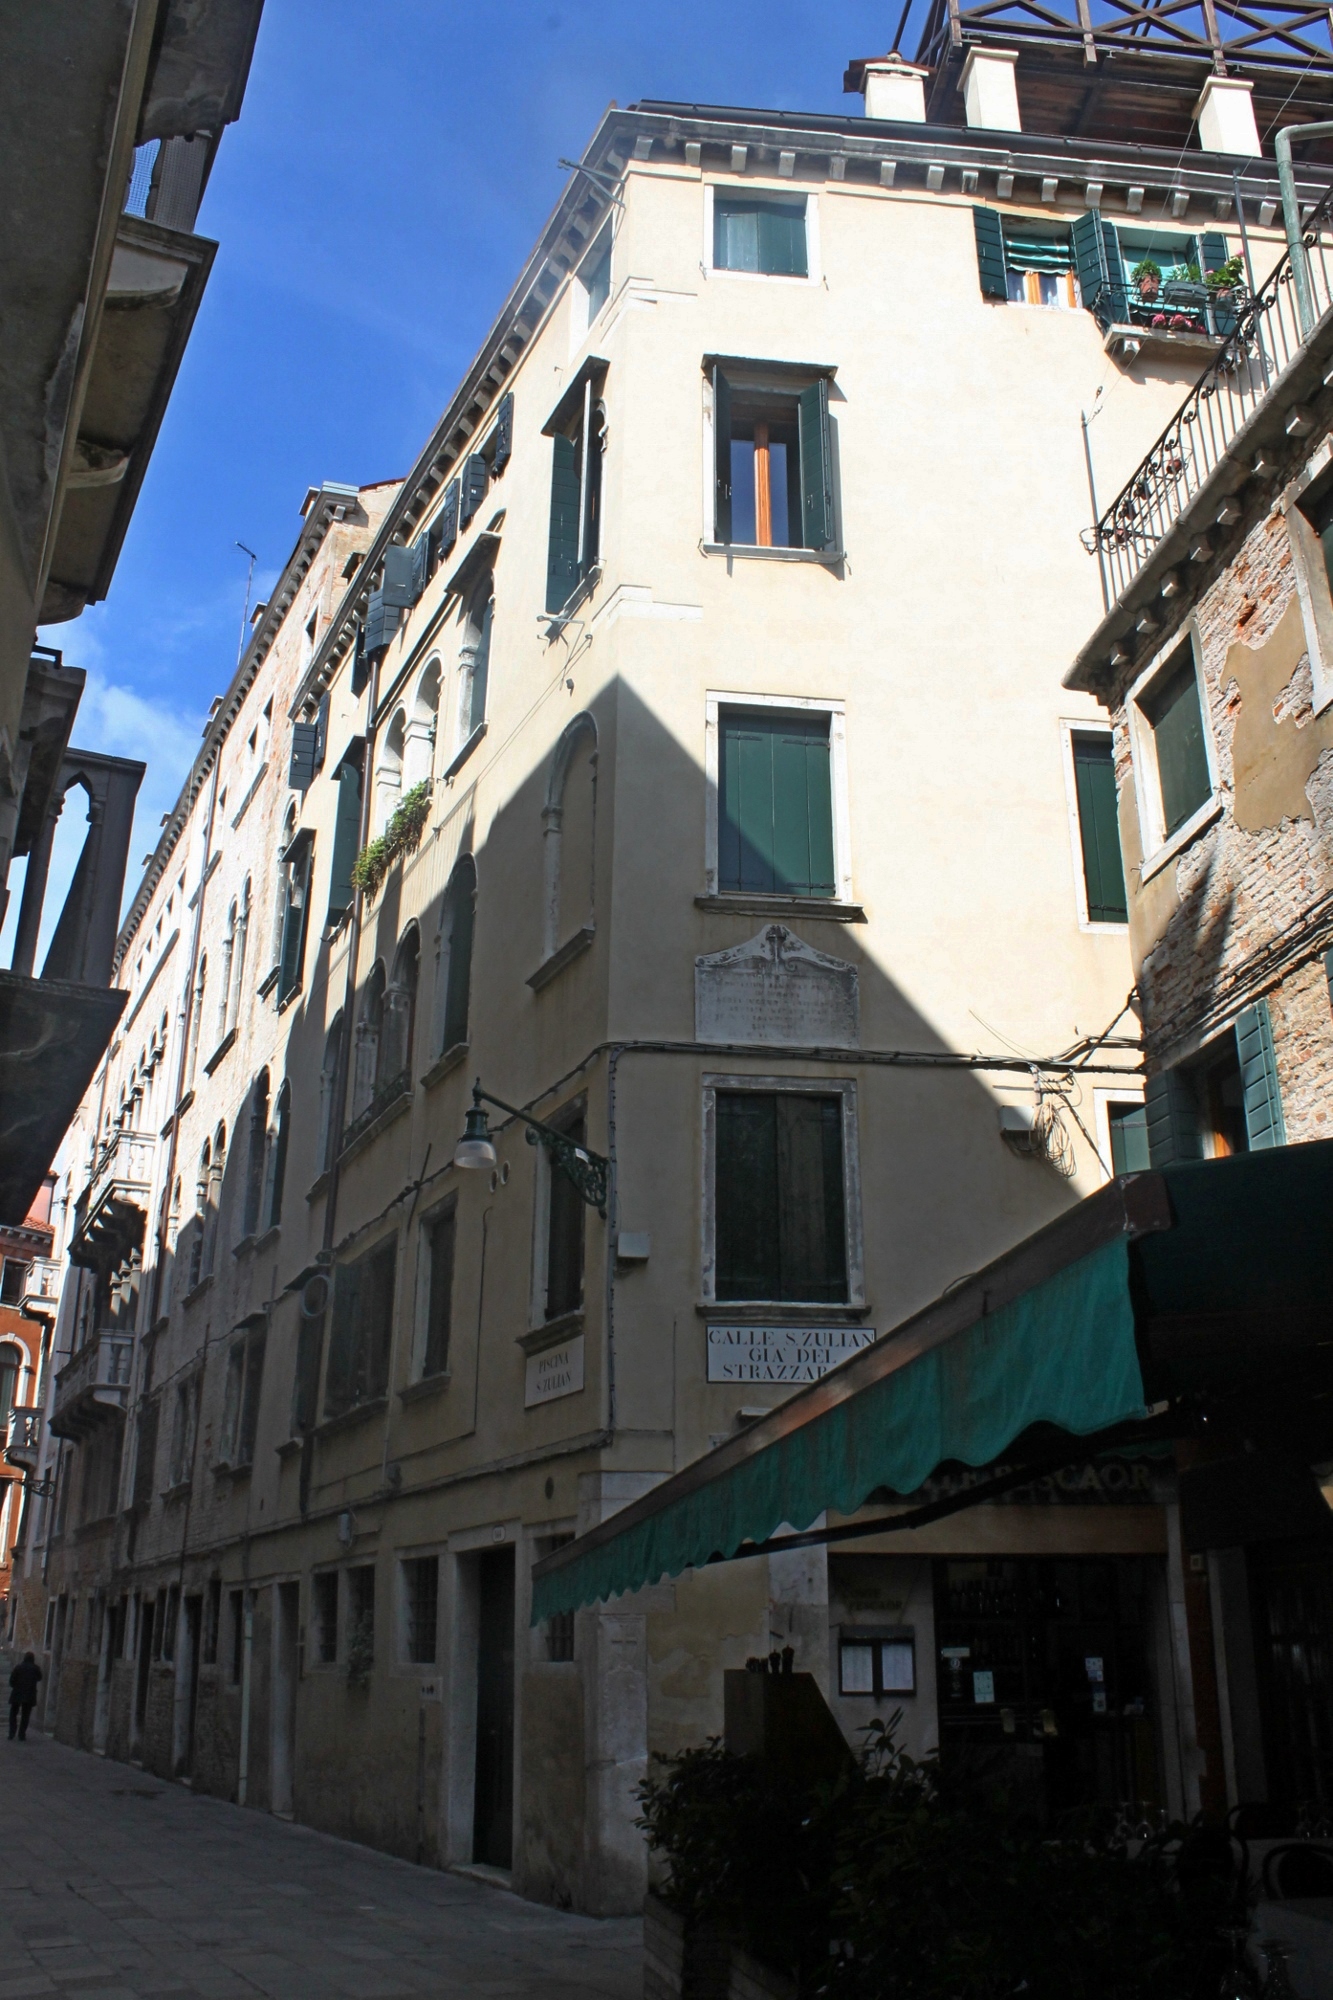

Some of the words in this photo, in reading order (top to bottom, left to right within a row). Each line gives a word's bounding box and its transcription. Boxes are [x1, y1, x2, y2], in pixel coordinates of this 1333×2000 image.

[709, 1330, 775, 1346] CALLE
[539, 1352, 569, 1374] PISCINA
[797, 1348, 836, 1364] DEL
